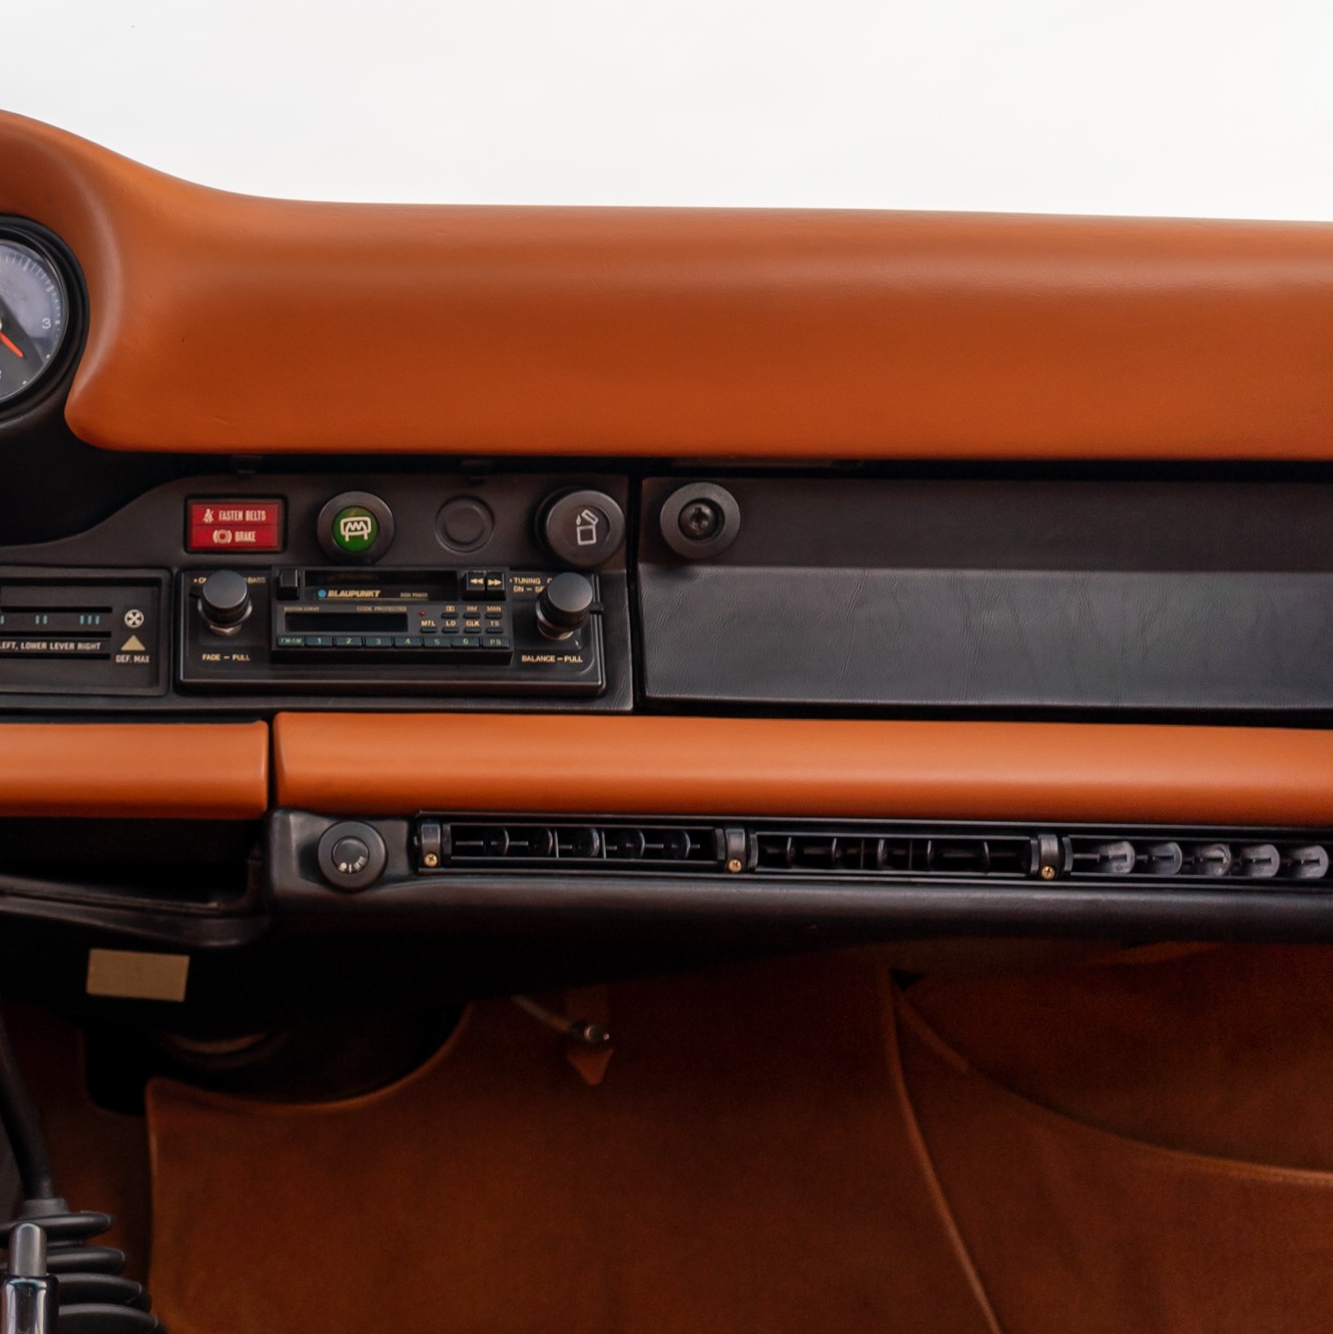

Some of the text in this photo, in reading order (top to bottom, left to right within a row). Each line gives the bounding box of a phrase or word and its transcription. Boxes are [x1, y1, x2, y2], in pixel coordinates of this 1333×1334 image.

[42, 318, 51, 329] 3
[218, 510, 267, 521] FASTEN BELTS
[234, 531, 257, 542] BRAKE
[514, 577, 541, 585] TUNING
[327, 589, 381, 598] BLAUPUNKT
[20, 642, 48, 650] LOWER
[49, 642, 75, 650] LEVER
[77, 642, 102, 651] RIGHT
[116, 655, 151, 664] DEF. MAX
[521, 655, 555, 663] BALANCE
[564, 655, 583, 663] PULL
